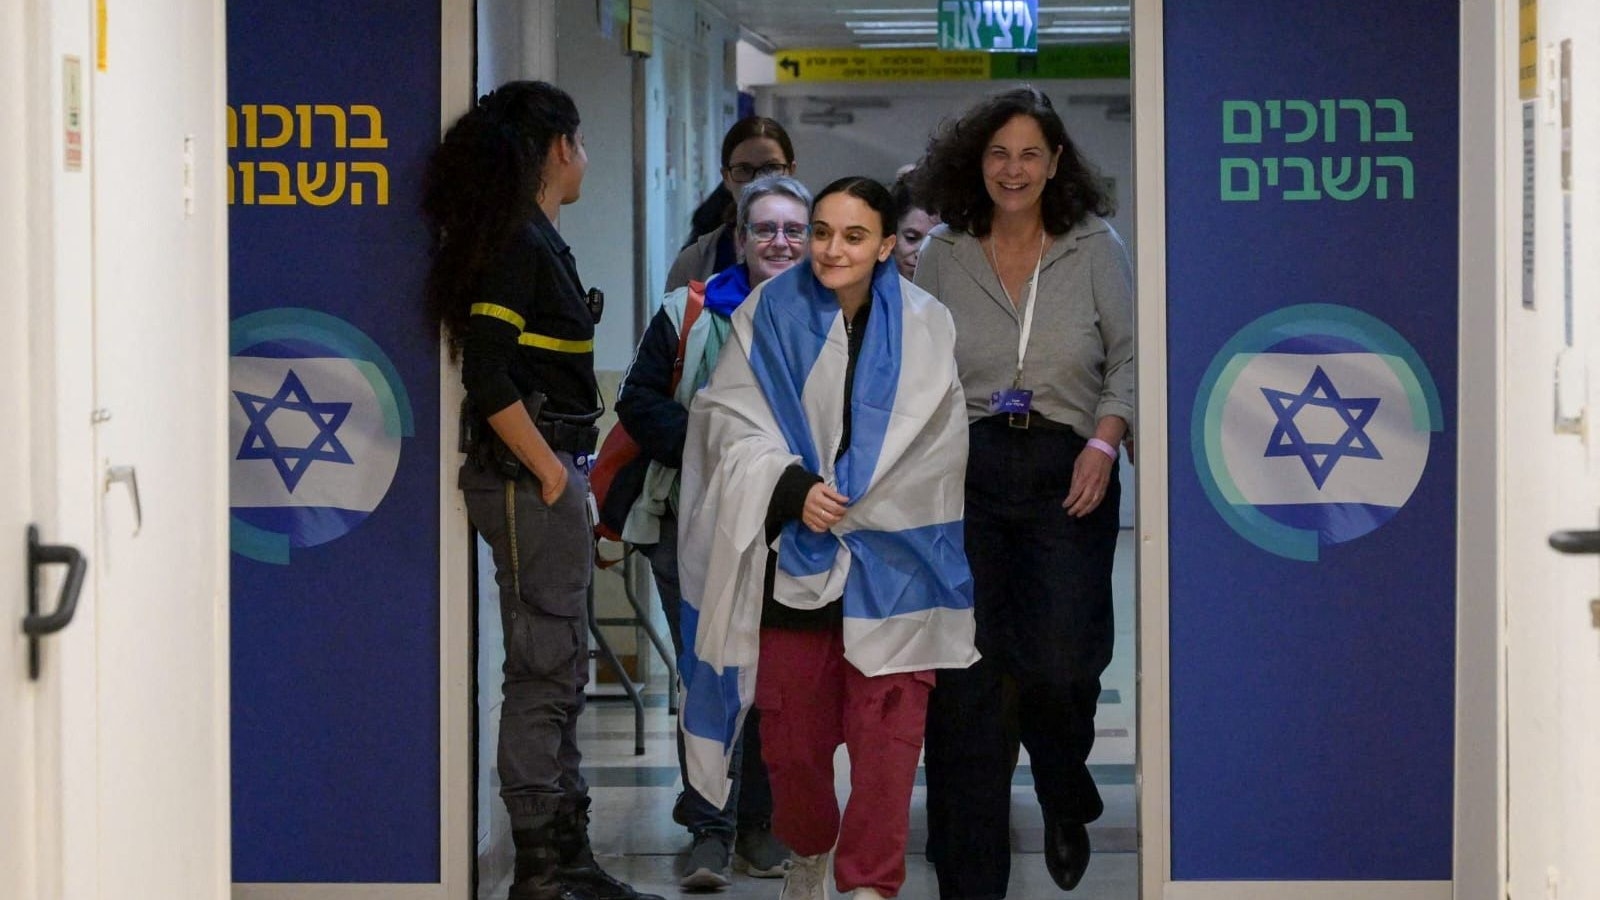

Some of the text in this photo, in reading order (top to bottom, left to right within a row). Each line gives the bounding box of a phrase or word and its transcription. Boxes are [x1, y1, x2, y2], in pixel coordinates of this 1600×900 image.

[942, 0, 1024, 48] יציאה
[1222, 98, 1414, 143] ברוכים
[228, 161, 389, 206] השבו
[1220, 155, 1415, 201] השבים
